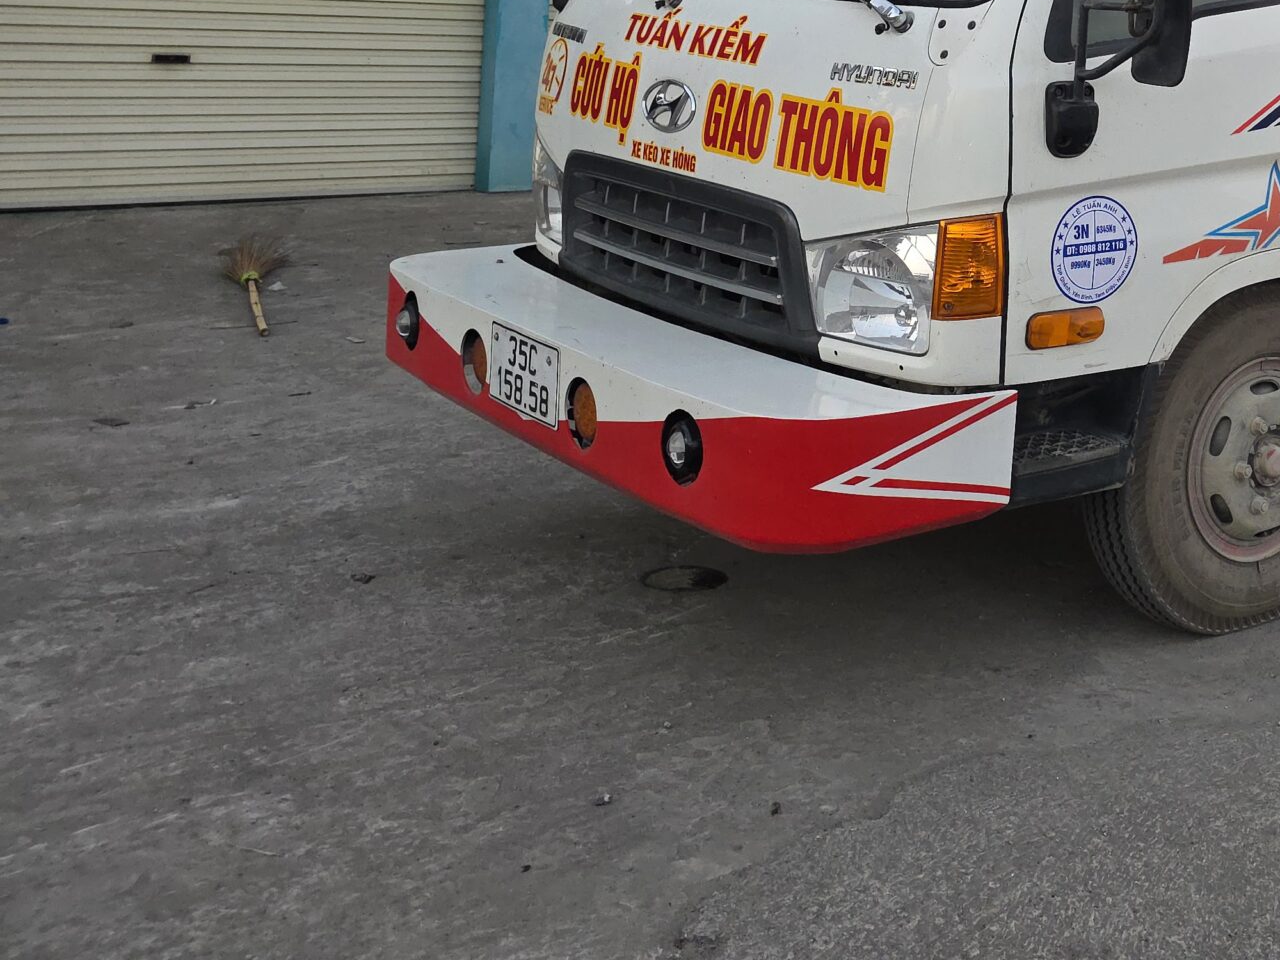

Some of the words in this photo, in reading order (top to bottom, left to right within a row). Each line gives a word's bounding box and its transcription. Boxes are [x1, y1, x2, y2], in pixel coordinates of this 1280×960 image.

[624, 7, 692, 52] TUẤN
[687, 14, 768, 66] KIỂM
[830, 61, 920, 90] HYUNDAI
[604, 51, 642, 147] HỘ
[702, 78, 774, 164] GIAO
[773, 87, 894, 193] THÔNG
[631, 140, 642, 159] XE
[642, 140, 659, 163] KÉO
[659, 146, 671, 167] XE
[1072, 207, 1082, 219] LÊ
[1082, 200, 1102, 211] TUẤN
[1103, 203, 1118, 215] ANH
[1073, 223, 1090, 240] 3N
[1079, 243, 1096, 254] 0988
[1097, 242, 1111, 252] 812
[1112, 240, 1124, 250] 116
[508, 335, 538, 377] 35C
[498, 365, 549, 418] 158.58
